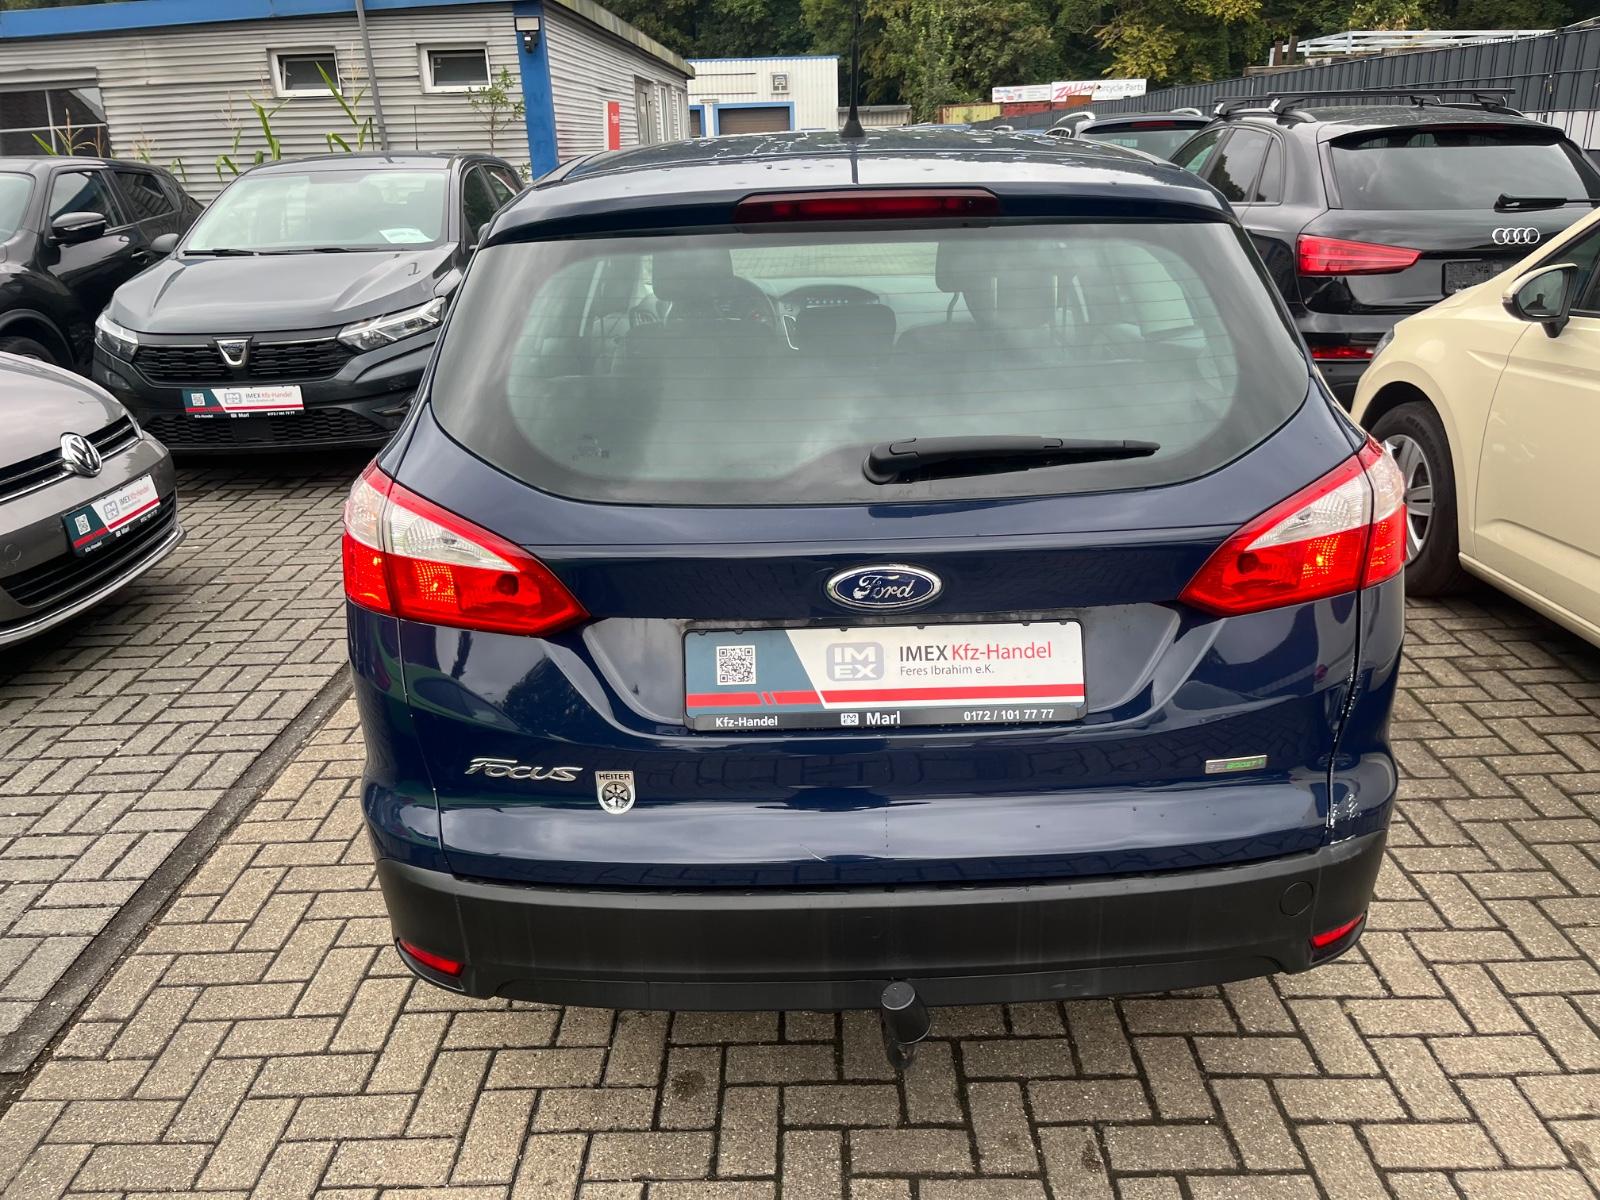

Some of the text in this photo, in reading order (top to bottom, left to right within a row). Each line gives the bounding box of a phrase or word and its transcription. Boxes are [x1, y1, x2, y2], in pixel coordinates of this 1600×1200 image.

[853, 575, 915, 599] Ford
[899, 641, 1052, 662] IMEX Kfz-Handel
[900, 663, 995, 676] Feres Ibrahim e.K.
[715, 715, 779, 728] Kfz-Handel
[866, 710, 901, 725] Marl
[963, 710, 991, 721] 0172
[1000, 709, 1020, 720] 101
[1023, 709, 1038, 719] 77
[1041, 708, 1055, 719] 77
